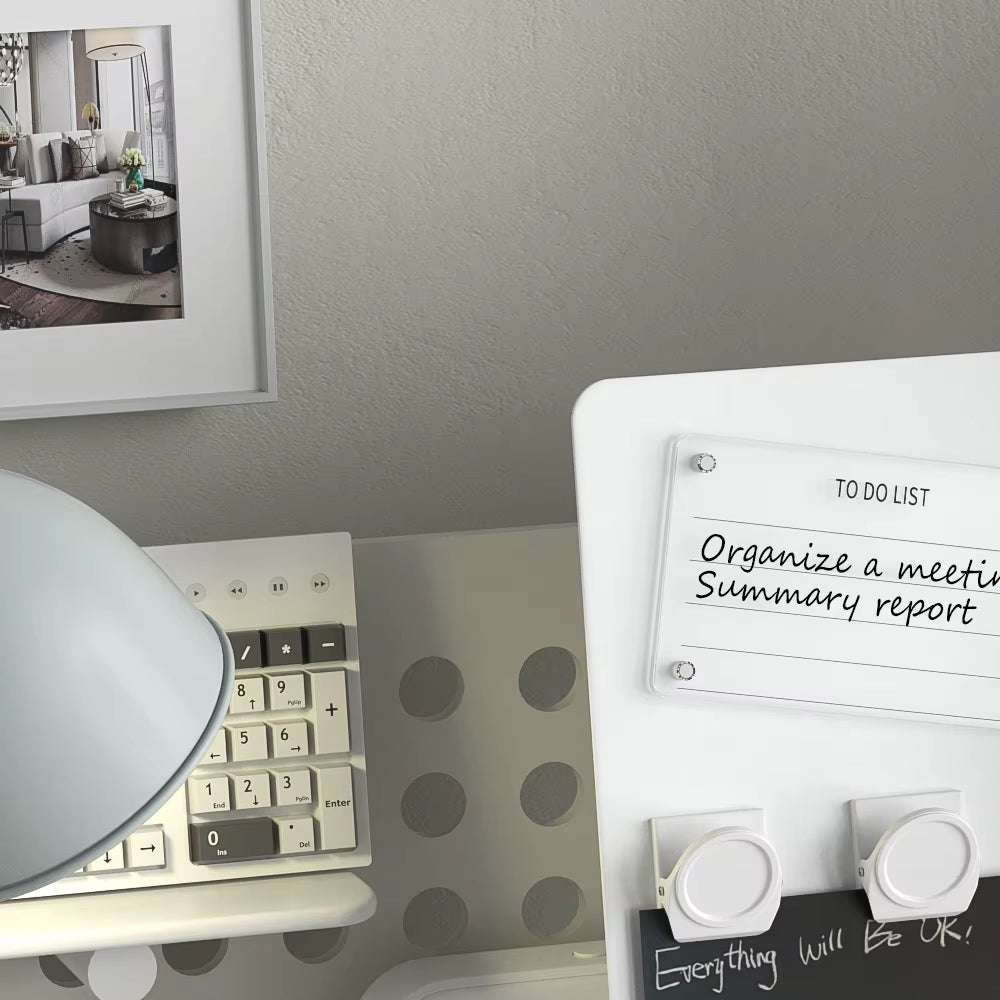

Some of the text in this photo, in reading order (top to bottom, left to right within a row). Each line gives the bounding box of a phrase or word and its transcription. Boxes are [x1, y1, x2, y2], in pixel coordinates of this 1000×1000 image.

[835, 478, 931, 507] TO DO LIST
[700, 533, 853, 574] Organize
[862, 556, 884, 578] a
[695, 571, 977, 627] Summary report
[237, 680, 286, 697] 8 9
[240, 727, 289, 744] 5 6
[205, 775, 292, 796] 1 2 3
[325, 799, 351, 808] Enter
[207, 830, 219, 846] 0
[655, 940, 778, 994] Everything
